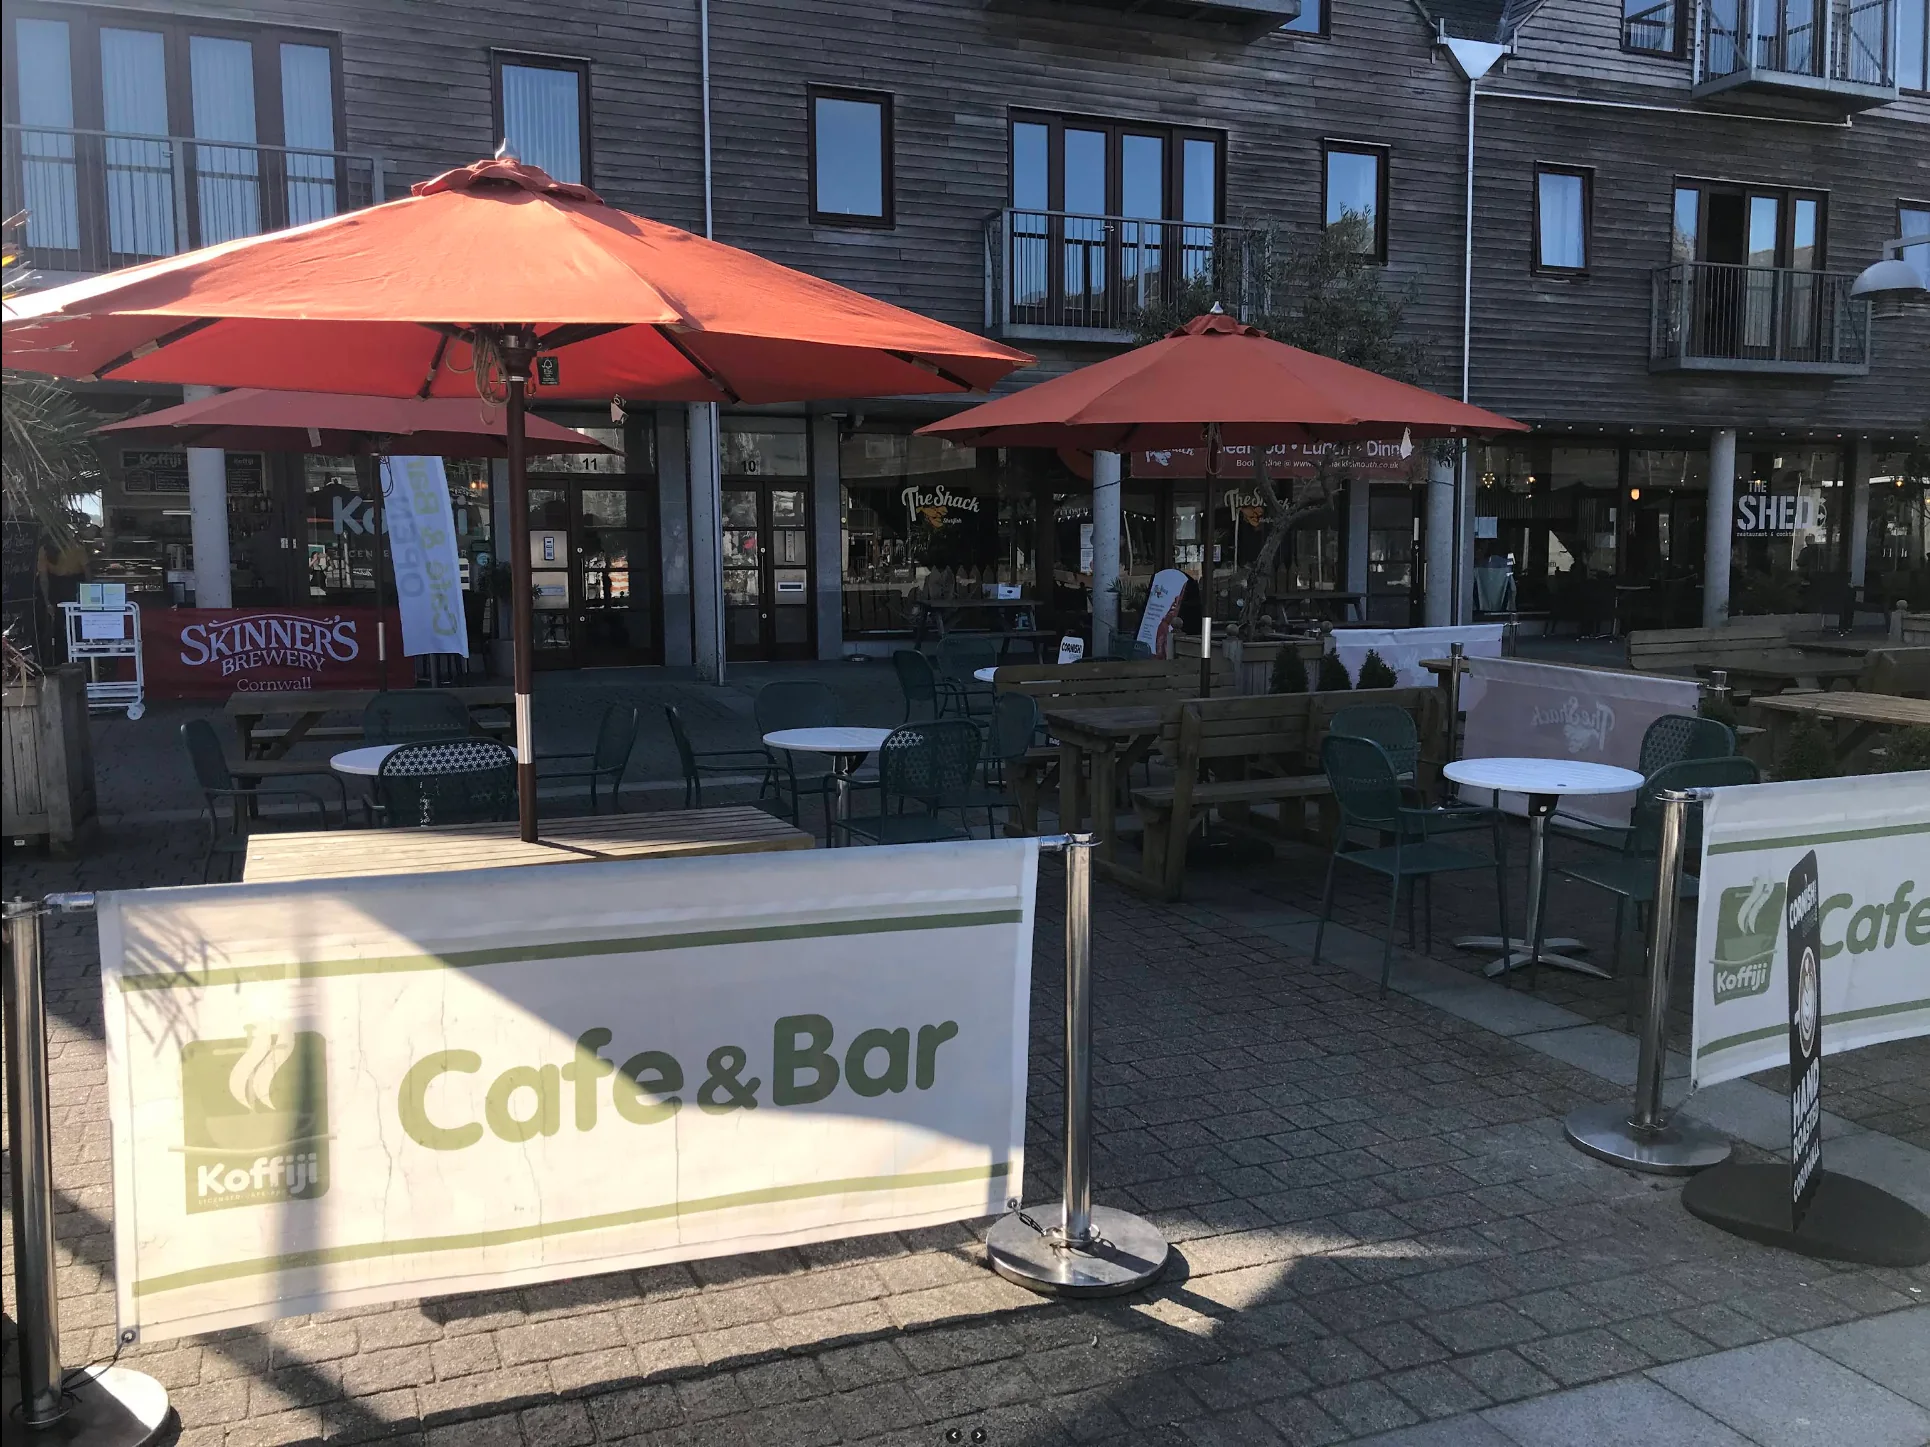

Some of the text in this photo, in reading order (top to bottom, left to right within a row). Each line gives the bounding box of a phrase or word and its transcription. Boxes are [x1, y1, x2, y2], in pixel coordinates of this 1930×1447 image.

[582, 457, 598, 471] 11
[741, 459, 756, 474] 10
[901, 484, 980, 522] The Shack
[1747, 480, 1767, 493] THE
[1223, 487, 1251, 522] The
[1737, 495, 1814, 531] SHED
[180, 615, 359, 666] SKINNER'S
[221, 650, 326, 676] BREWERY
[236, 677, 312, 692] Cornwall
[1820, 880, 1930, 960] Cafe
[1716, 962, 1768, 994] Koffiji
[397, 1013, 959, 1151] Cafe & Bar
[1793, 1057, 1820, 1135] HAND
[197, 1152, 318, 1195] Koffiji
